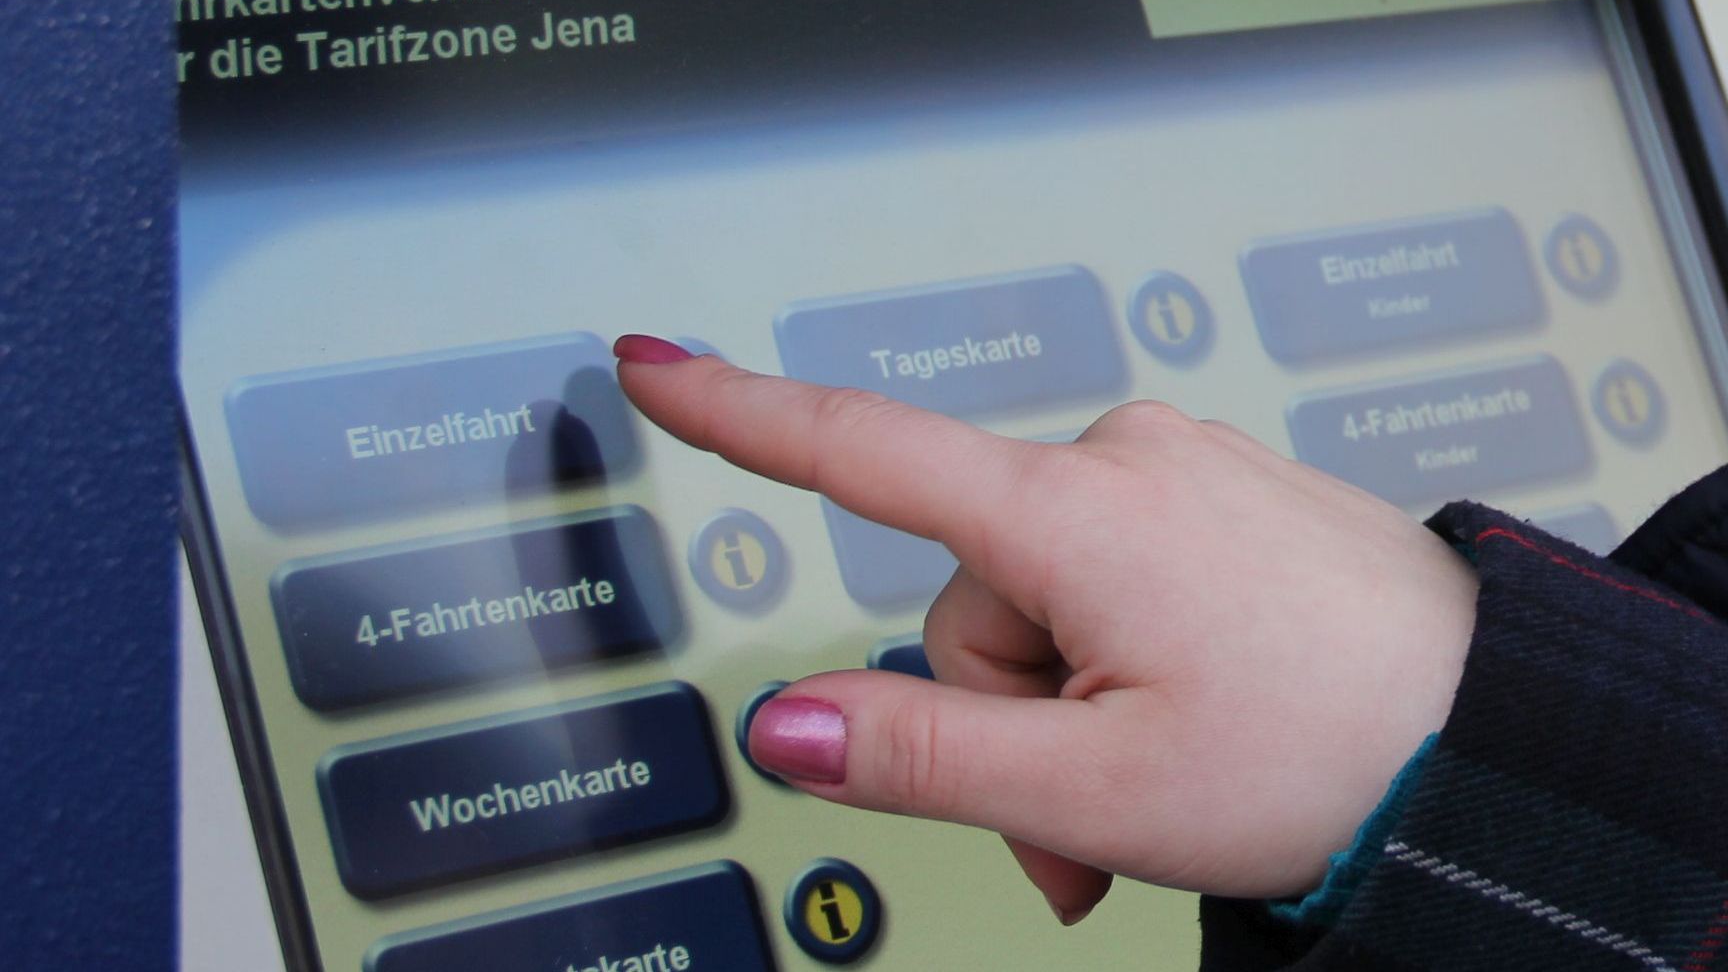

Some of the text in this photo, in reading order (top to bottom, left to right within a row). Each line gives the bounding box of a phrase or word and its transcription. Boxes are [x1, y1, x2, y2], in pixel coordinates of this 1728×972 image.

[209, 36, 284, 80] die
[296, 24, 518, 71] Tarifzone
[530, 12, 637, 51] Jena
[1319, 241, 1460, 285] Einzelfahrt
[1367, 295, 1431, 319] Kinder
[869, 331, 1042, 380] Tageskarte
[345, 404, 536, 461] Einzelfahrt
[1341, 388, 1532, 443] 4-Fahrtenkarte
[1414, 445, 1479, 471] Kinder
[355, 575, 616, 648] 4-Fahrtenkarte
[409, 755, 651, 833] Wochenkarte
